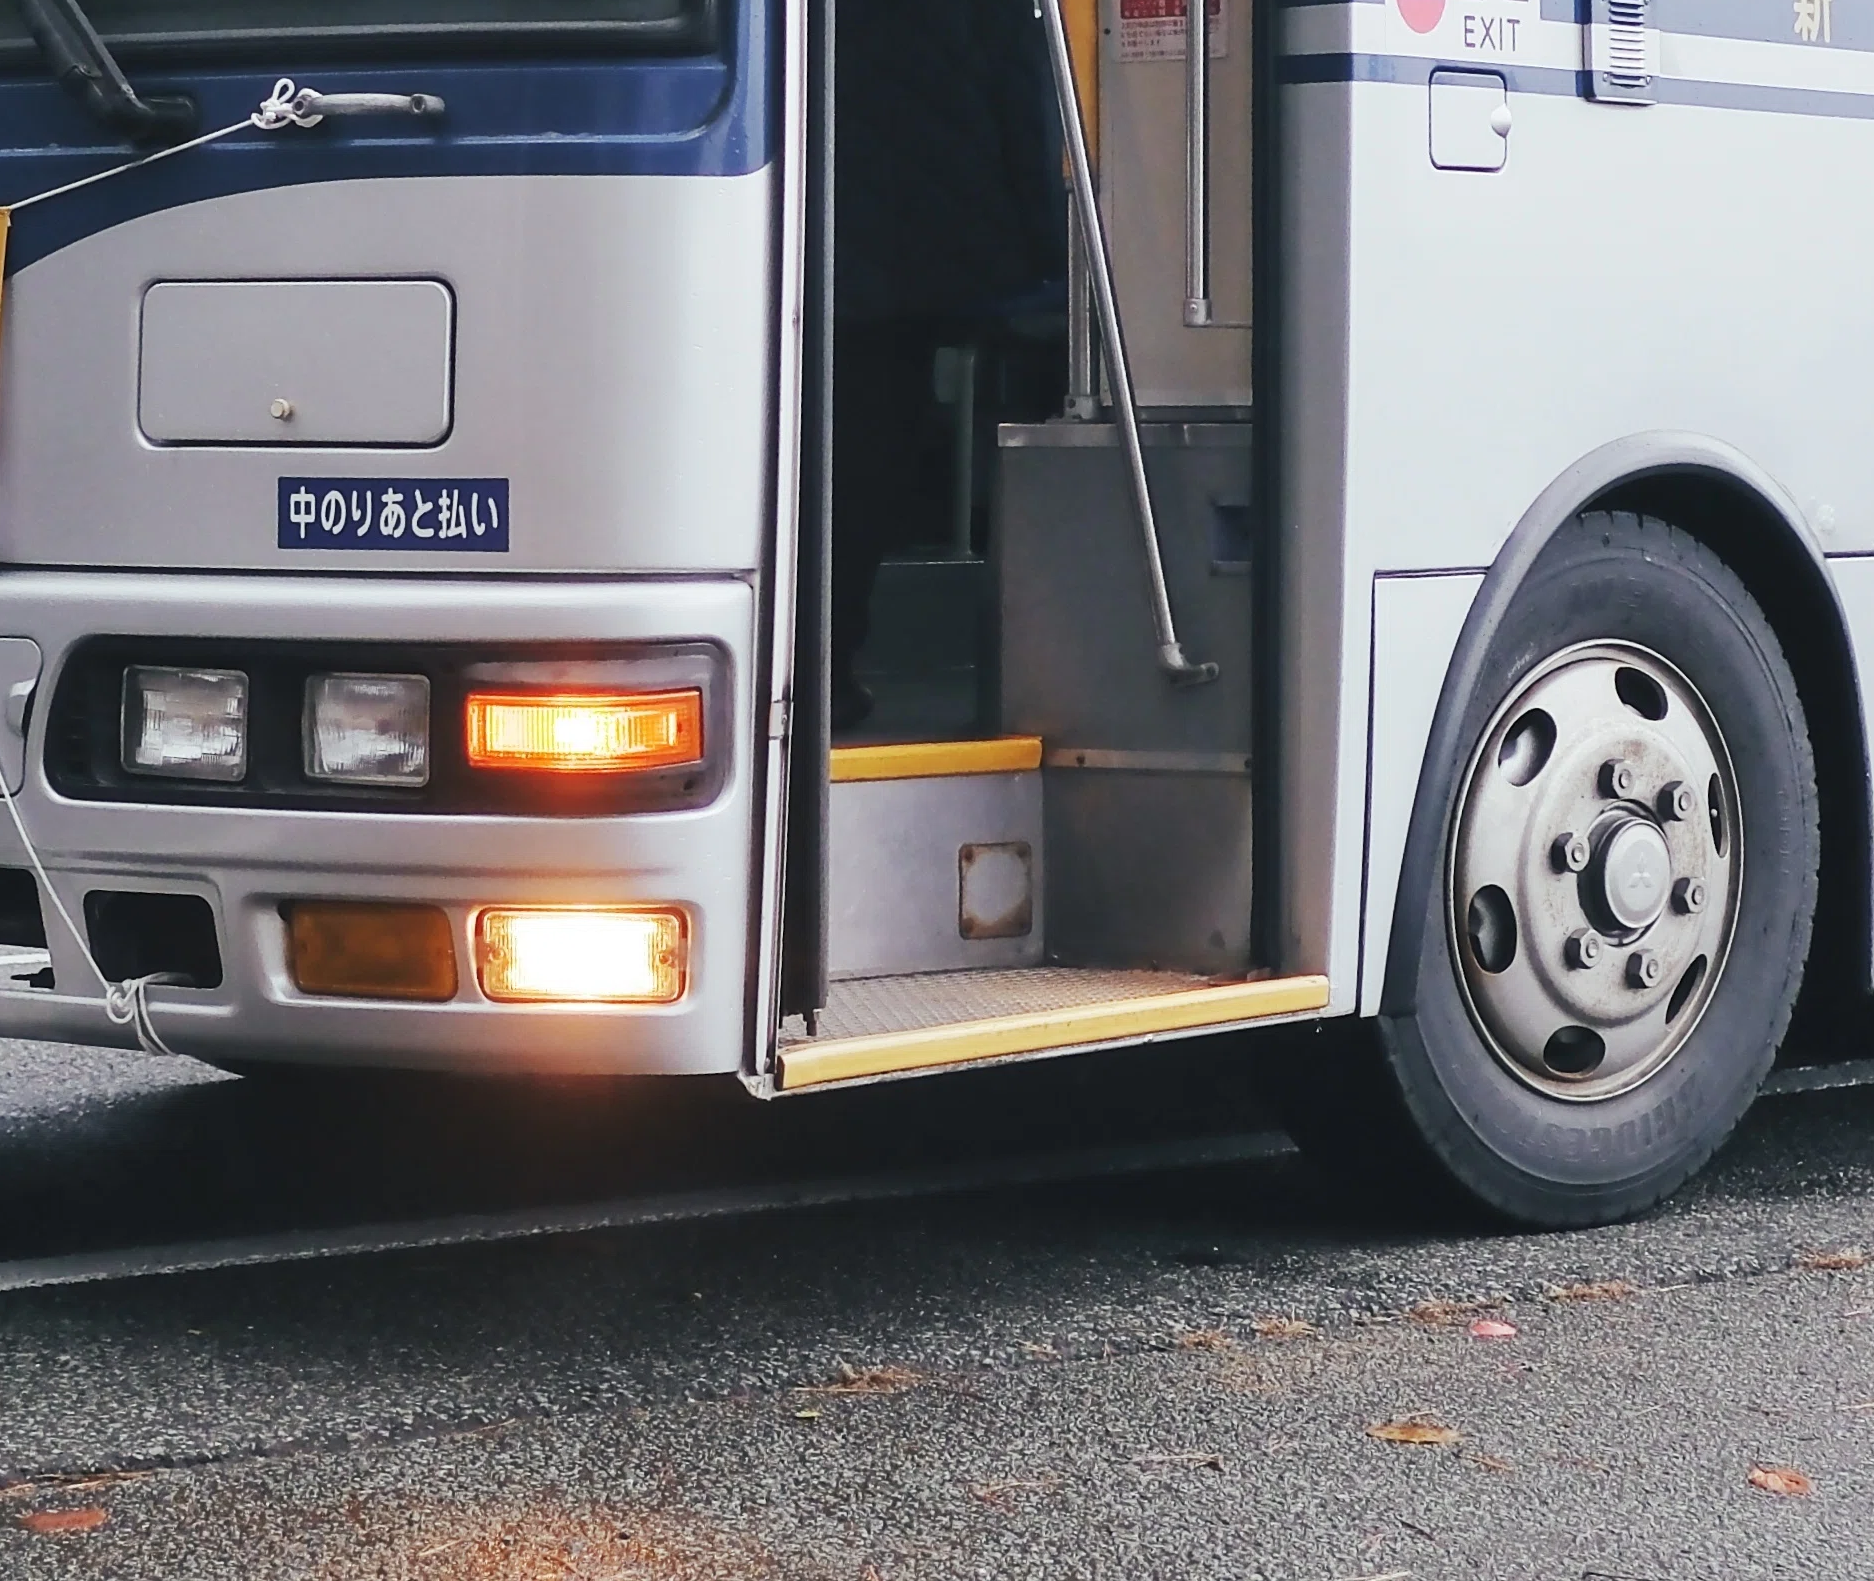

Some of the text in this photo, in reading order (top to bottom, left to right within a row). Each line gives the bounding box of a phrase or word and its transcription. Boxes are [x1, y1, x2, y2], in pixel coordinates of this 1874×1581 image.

[1463, 15, 1521, 52] EXIT
[289, 486, 499, 538] 中のりあと払い
